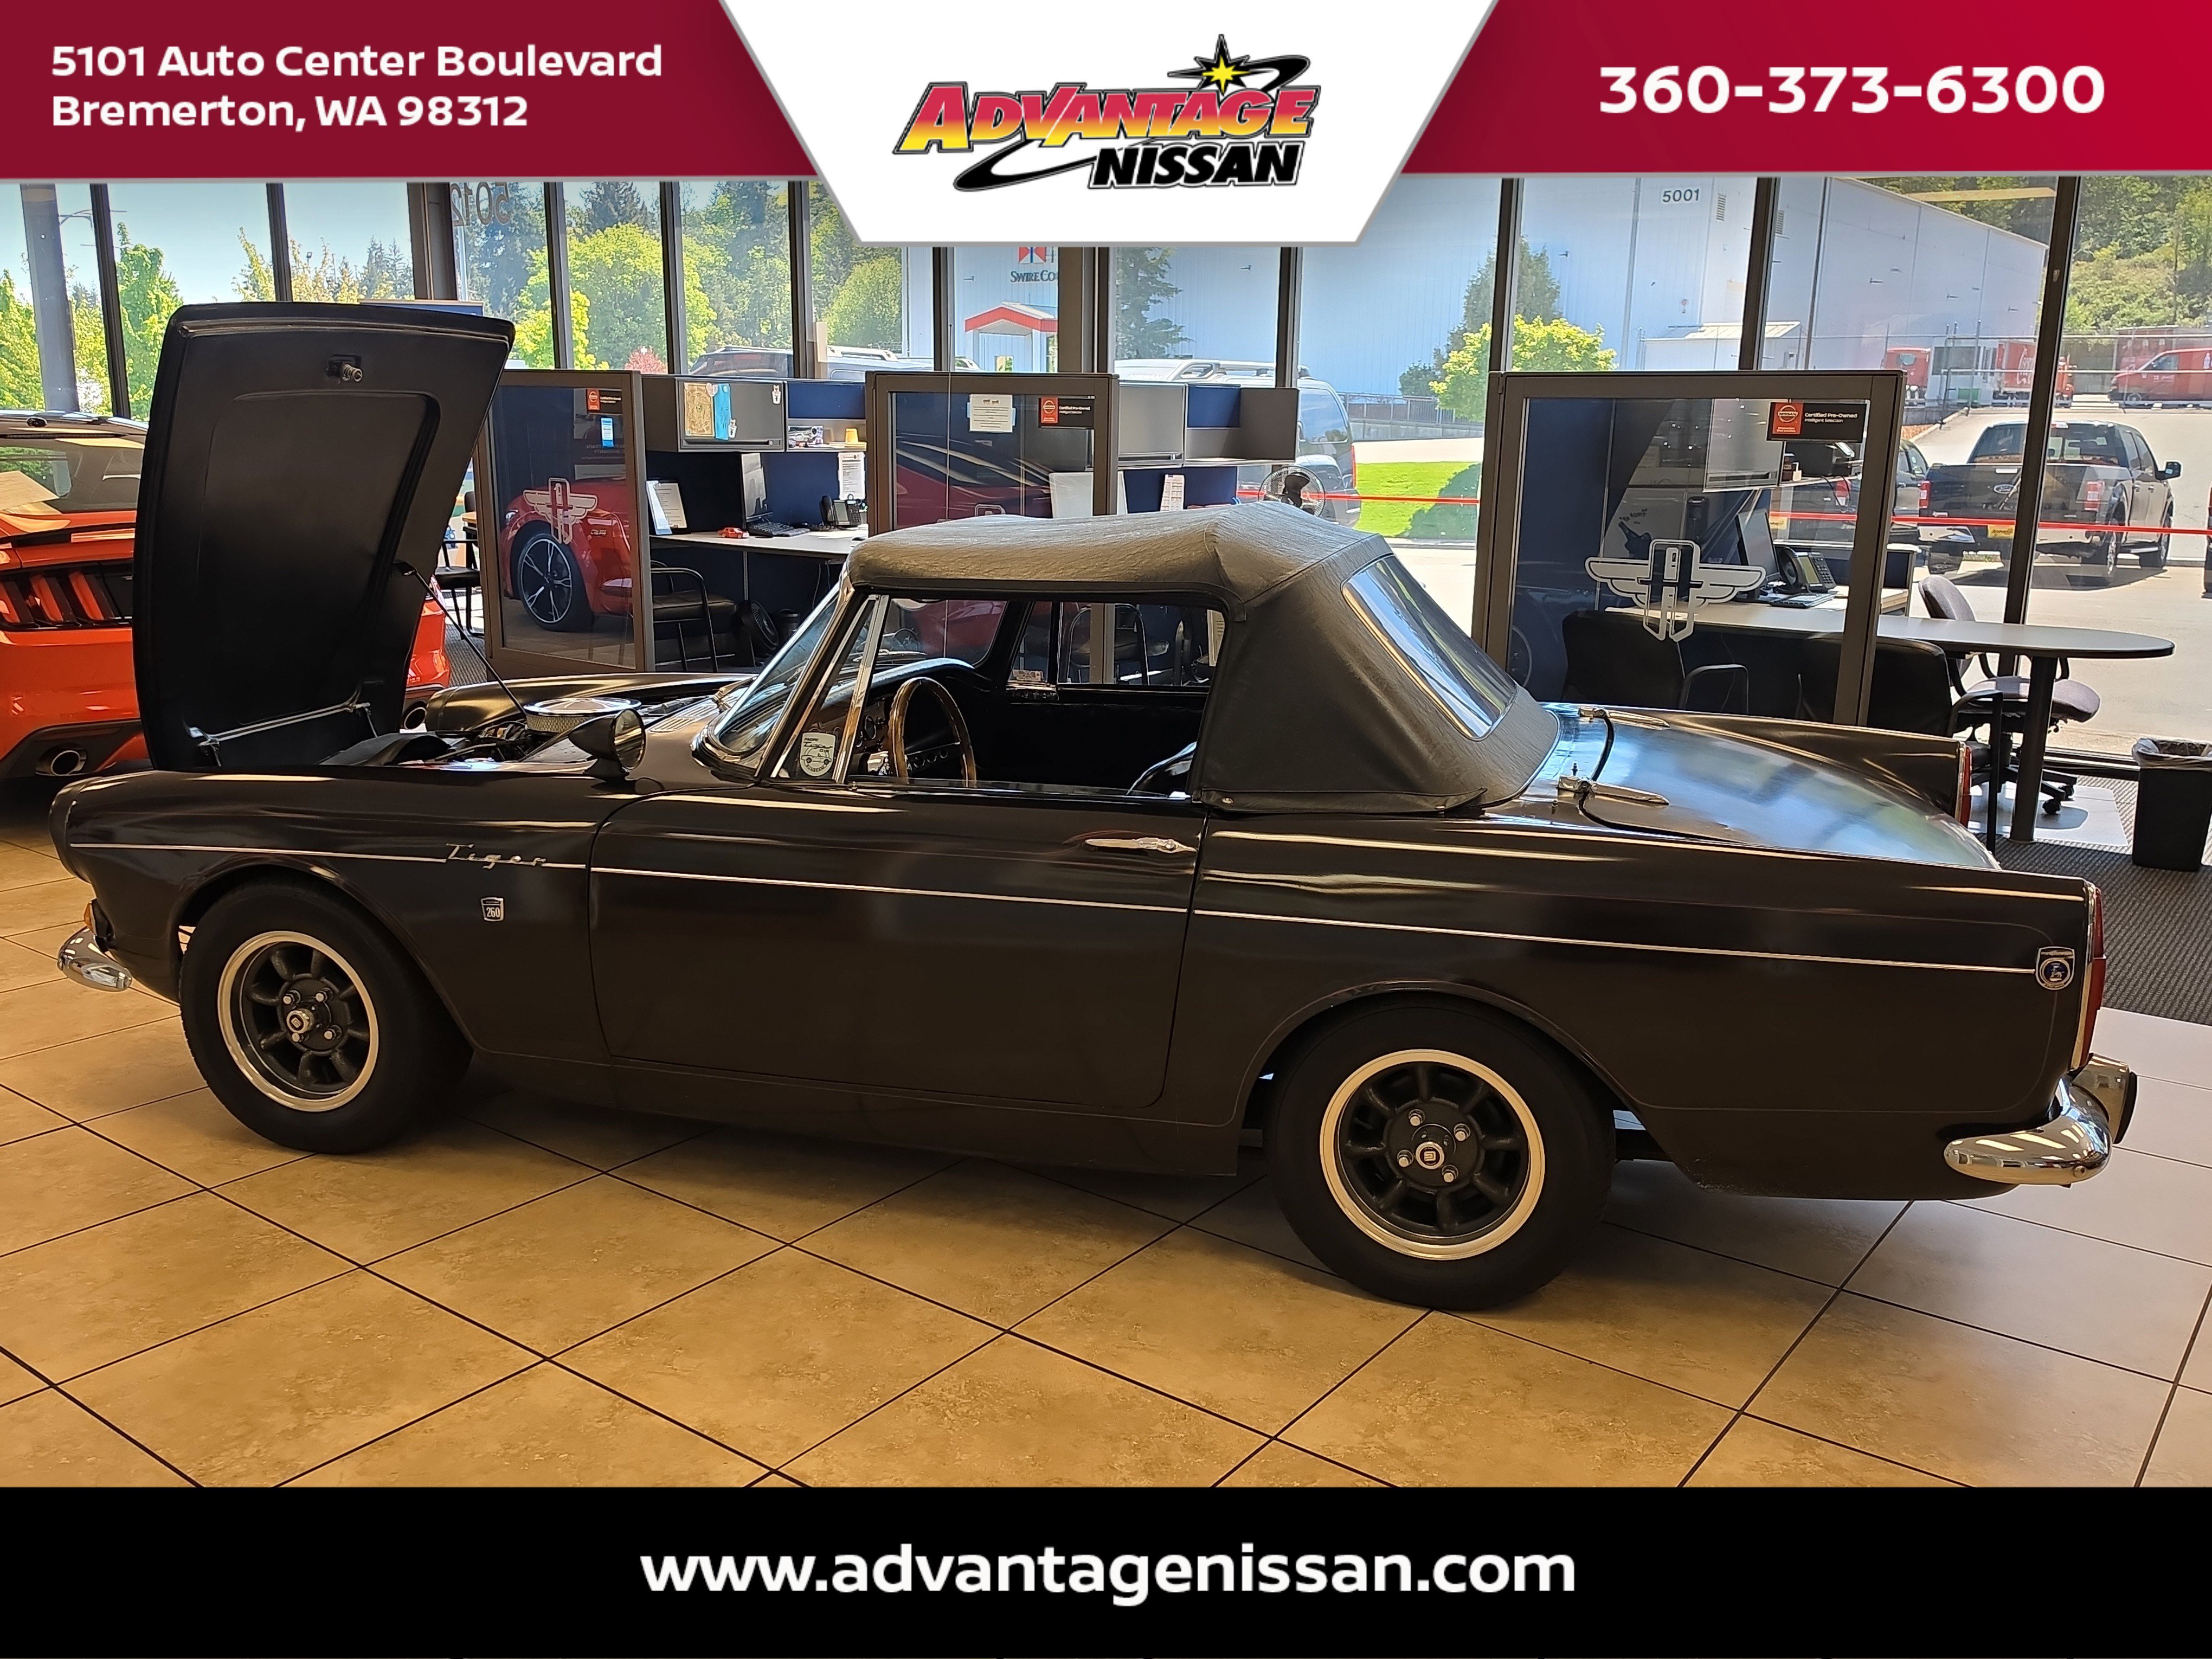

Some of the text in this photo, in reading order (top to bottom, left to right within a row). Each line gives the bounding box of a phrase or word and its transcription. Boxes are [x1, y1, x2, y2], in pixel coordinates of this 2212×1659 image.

[1662, 189, 1699, 202] 5001
[446, 844, 546, 870] Tiger
[486, 907, 500, 917] 260
